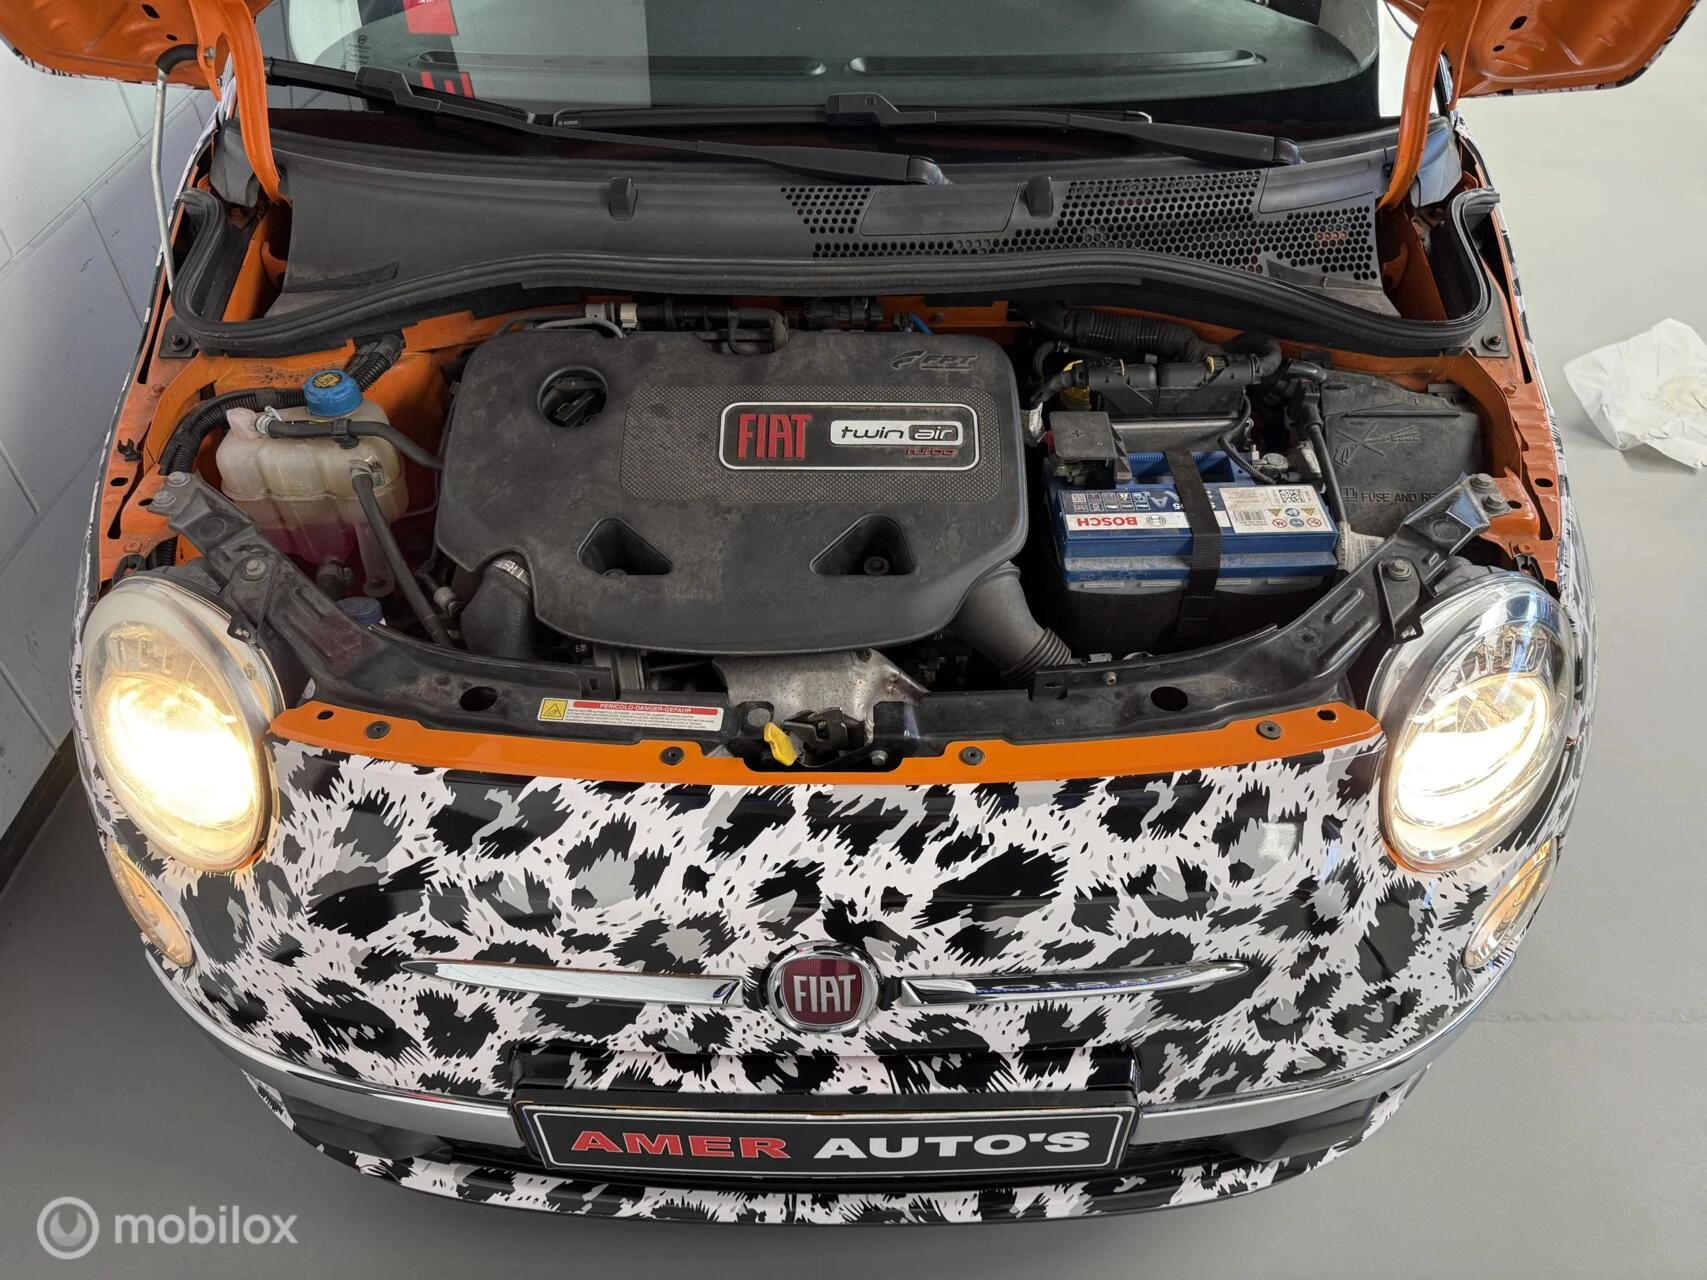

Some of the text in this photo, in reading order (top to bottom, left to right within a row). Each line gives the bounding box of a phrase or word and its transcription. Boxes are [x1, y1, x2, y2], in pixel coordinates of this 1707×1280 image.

[737, 413, 812, 458] FIAT
[840, 426, 953, 441] twin air
[1361, 492, 1390, 502] FUSE
[1394, 492, 1416, 503] AND
[1077, 516, 1139, 527] BOSCH
[792, 974, 858, 1014] FIAT
[570, 1129, 1091, 1160] AMER AUTO'S
